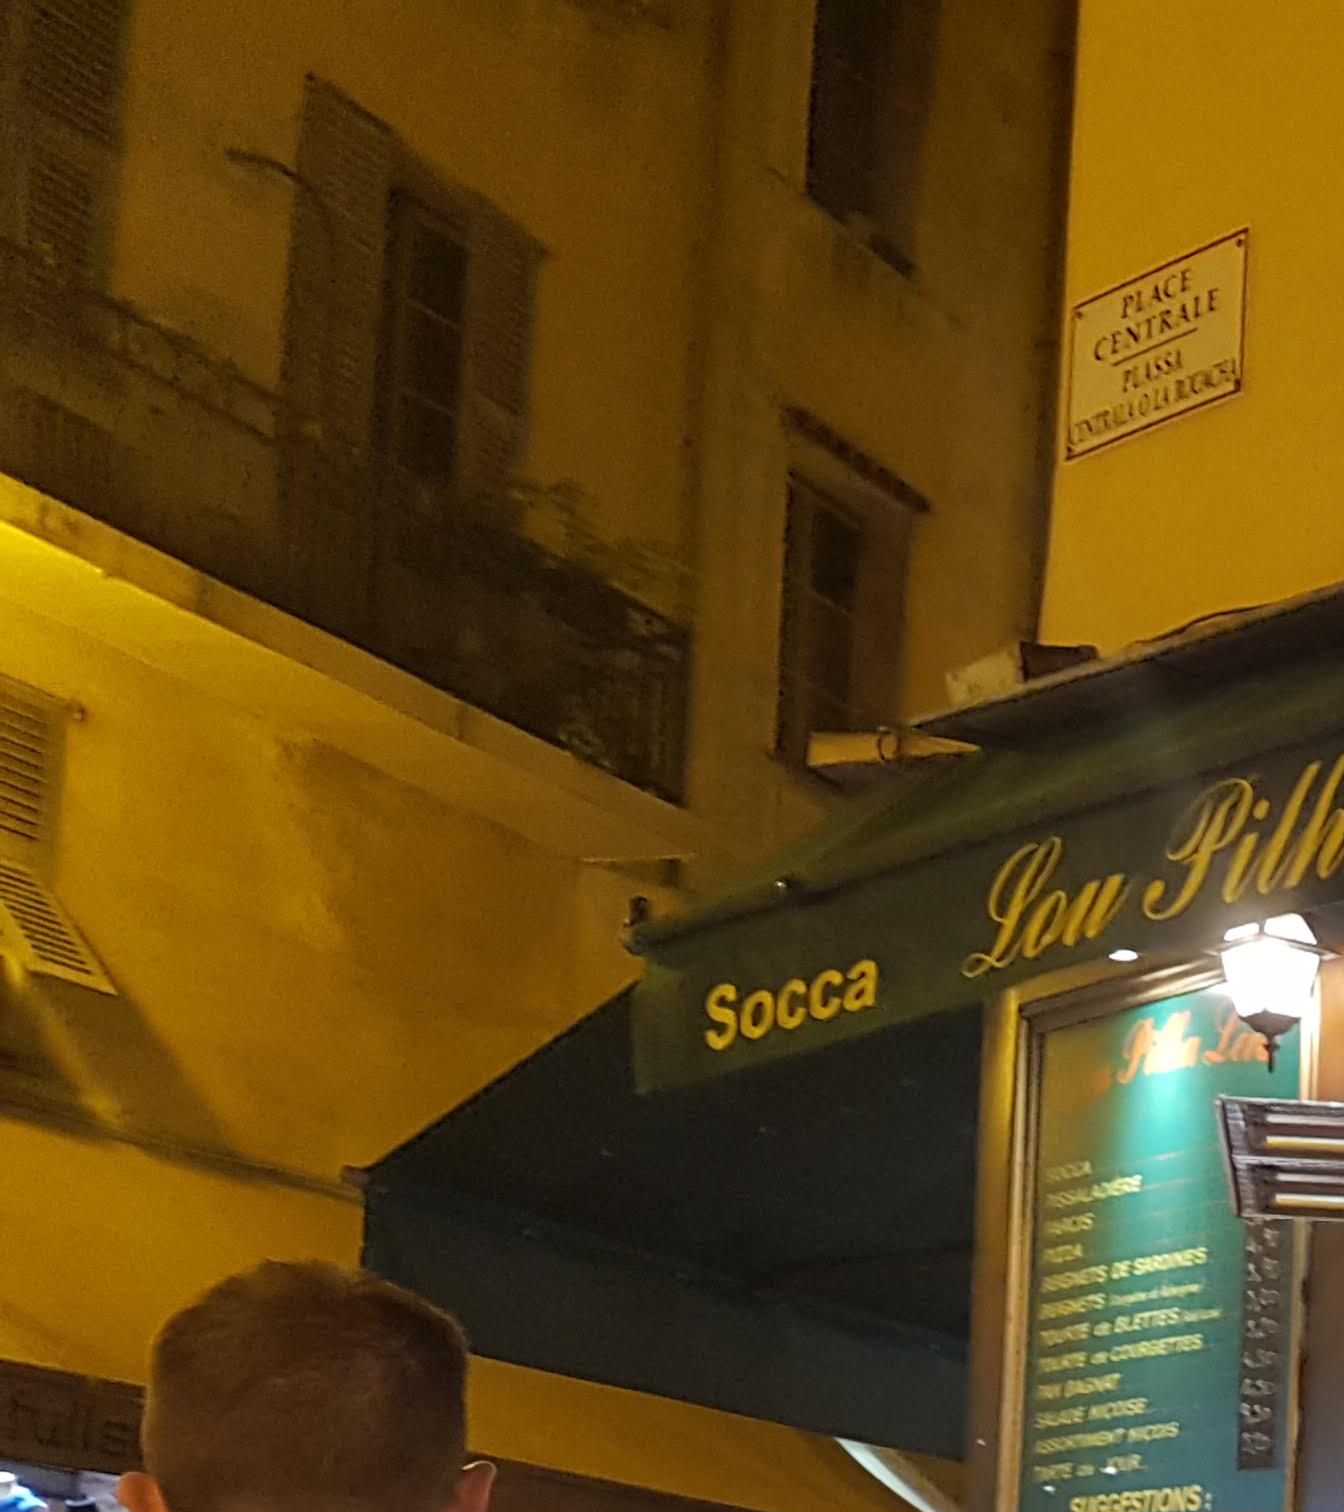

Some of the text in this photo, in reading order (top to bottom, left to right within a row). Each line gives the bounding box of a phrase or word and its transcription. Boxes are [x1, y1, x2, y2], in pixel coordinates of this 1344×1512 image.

[1094, 288, 1219, 361] CENTRALE
[1121, 269, 1191, 318] PLACE
[961, 835, 1132, 978] Lou
[705, 958, 880, 1051] Socca
